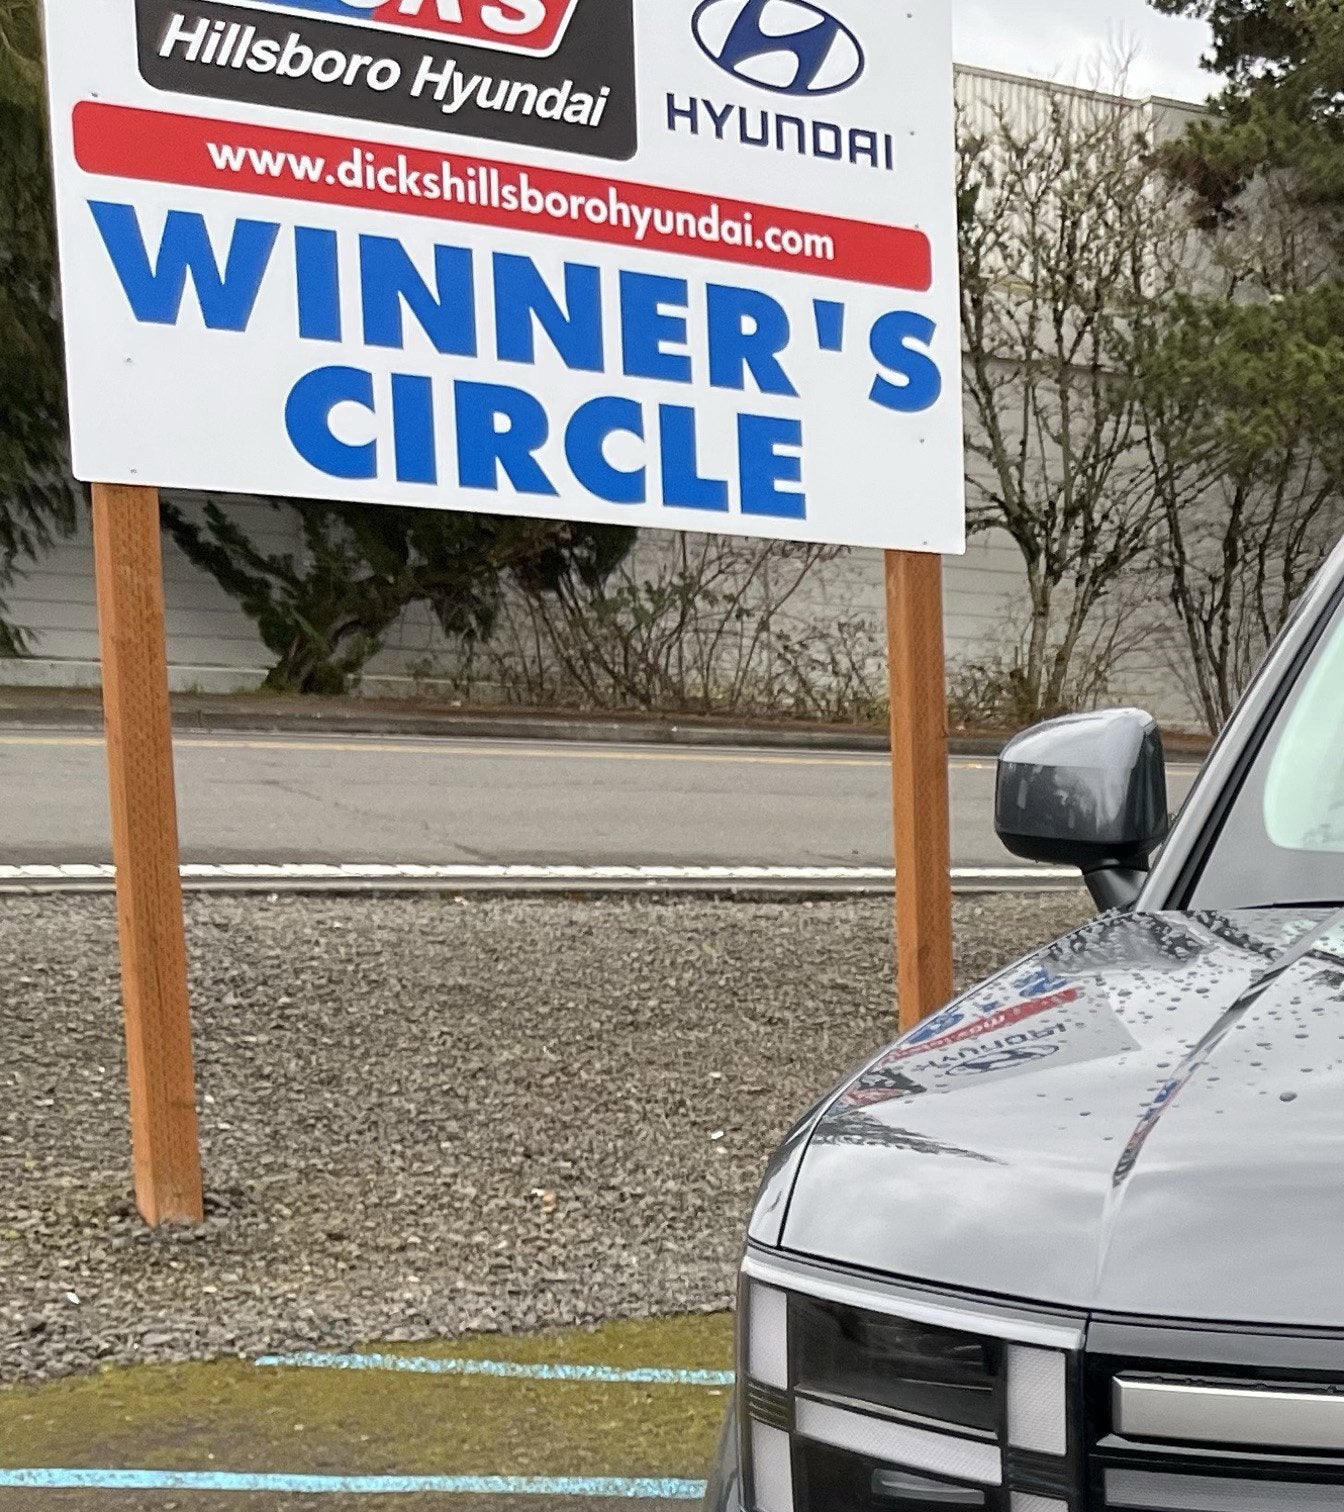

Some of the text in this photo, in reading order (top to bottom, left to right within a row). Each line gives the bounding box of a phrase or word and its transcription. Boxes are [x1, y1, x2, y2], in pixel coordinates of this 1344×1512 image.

[158, 13, 401, 92] Hillsboro
[409, 55, 611, 128] Hyundai
[666, 92, 894, 170] HYUNDAI
[207, 137, 836, 262] www.dickshillsborohyundai.com
[87, 199, 942, 413] WINNER'S
[285, 365, 807, 520] CIRCLE
